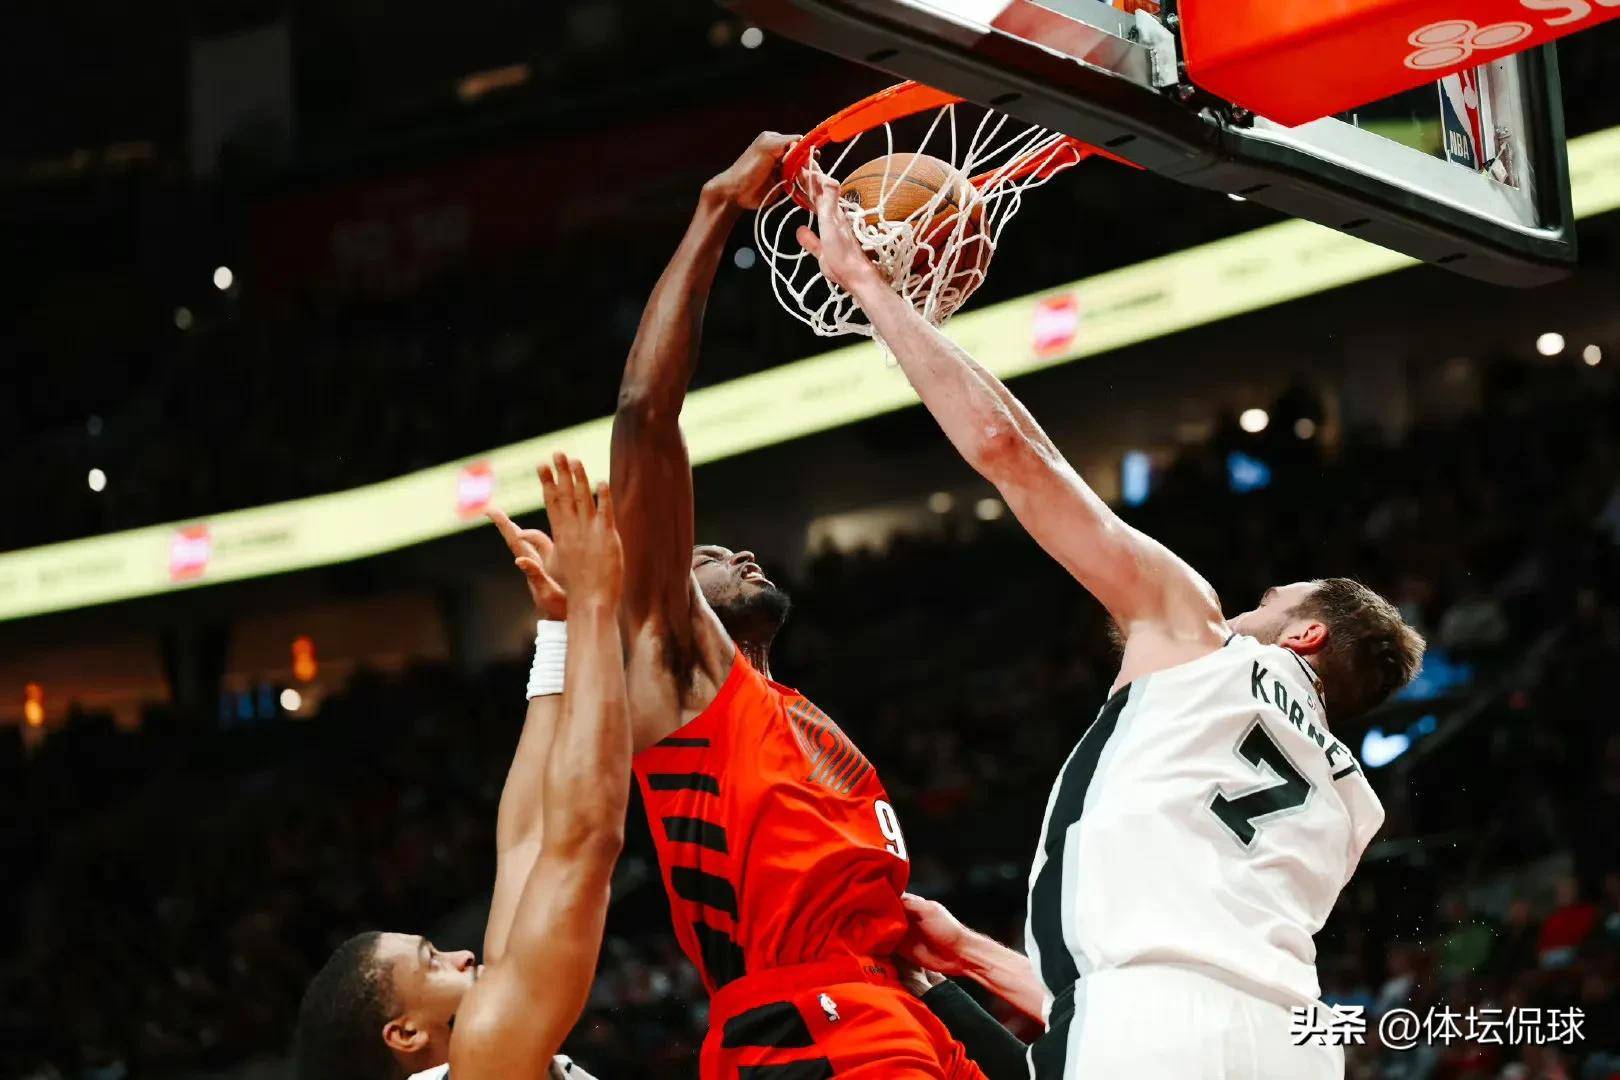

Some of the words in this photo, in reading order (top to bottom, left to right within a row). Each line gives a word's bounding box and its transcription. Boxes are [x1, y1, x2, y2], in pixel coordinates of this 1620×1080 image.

[1450, 130, 1470, 160] NBA
[1251, 660, 1362, 781] KORNET
[1206, 715, 1316, 848] 7
[875, 799, 907, 861] 9
